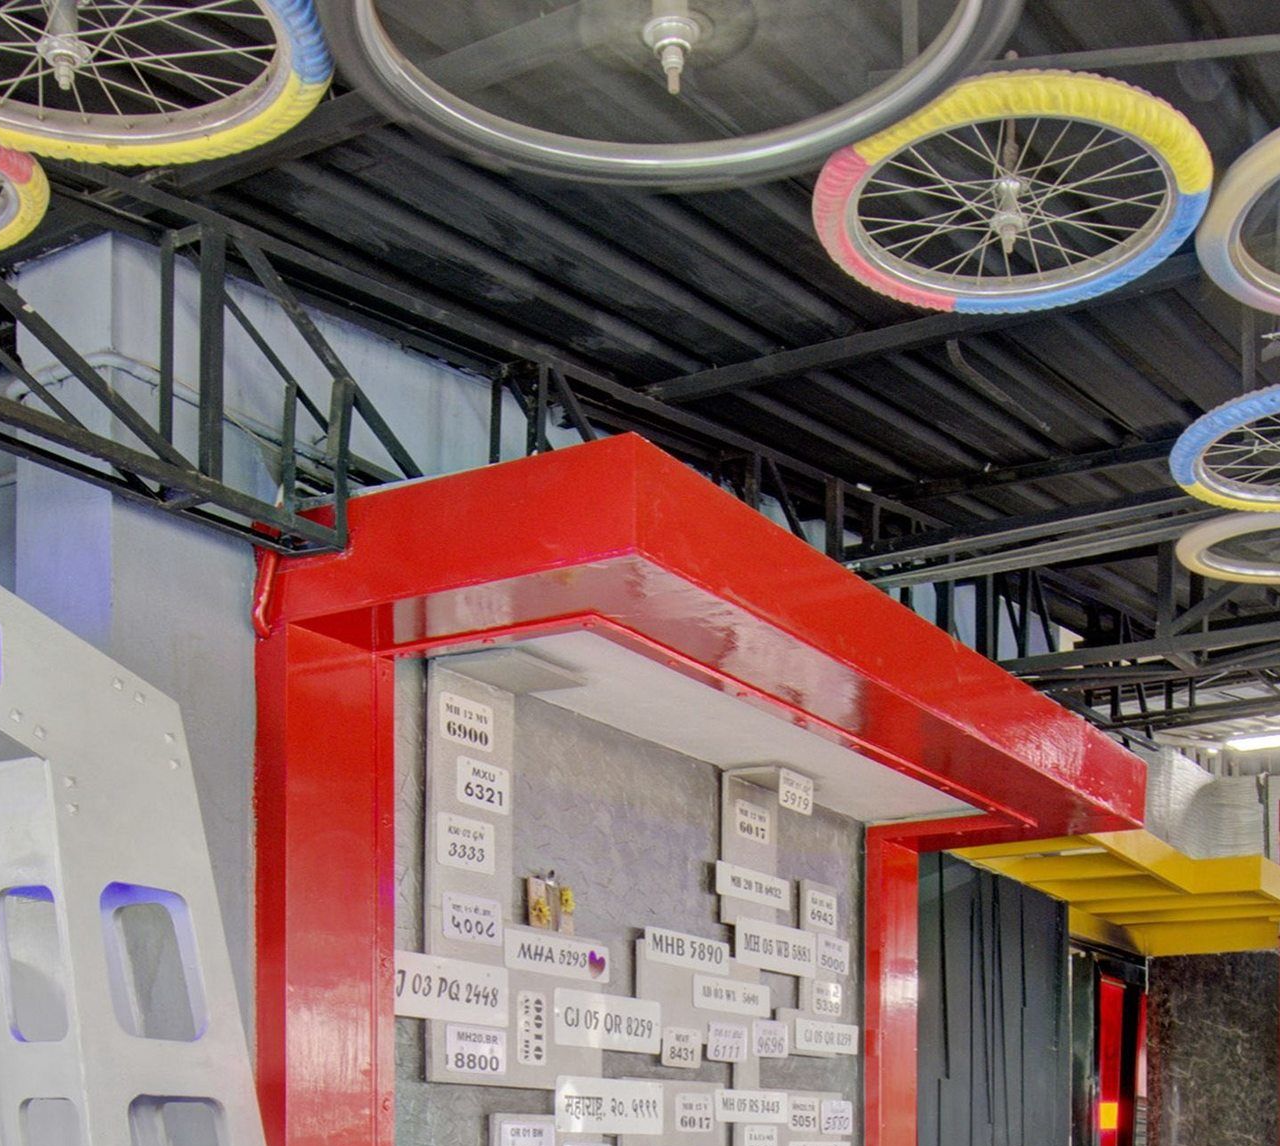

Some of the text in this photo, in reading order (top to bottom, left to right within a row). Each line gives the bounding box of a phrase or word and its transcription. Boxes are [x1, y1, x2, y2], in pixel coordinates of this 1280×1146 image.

[446, 720, 489, 747] 6900
[472, 767, 496, 782] MXU
[464, 782, 503, 807] 6321
[783, 790, 809, 810] 5919
[448, 842, 486, 863] 3333
[651, 932, 723, 965] MHB 5890
[743, 932, 761, 954] MH
[517, 943, 588, 969] MHA 5293
[412, 973, 433, 998] 03
[437, 976, 461, 1002] PQ
[465, 982, 500, 1009] 2448
[564, 1005, 654, 1040] GJ 05 QR 8259
[454, 1052, 500, 1072] 8800
[670, 1046, 695, 1062] 8431
[713, 1044, 740, 1059] 6111
[680, 1115, 711, 1130] 6017
[792, 1114, 817, 1128] 5051
